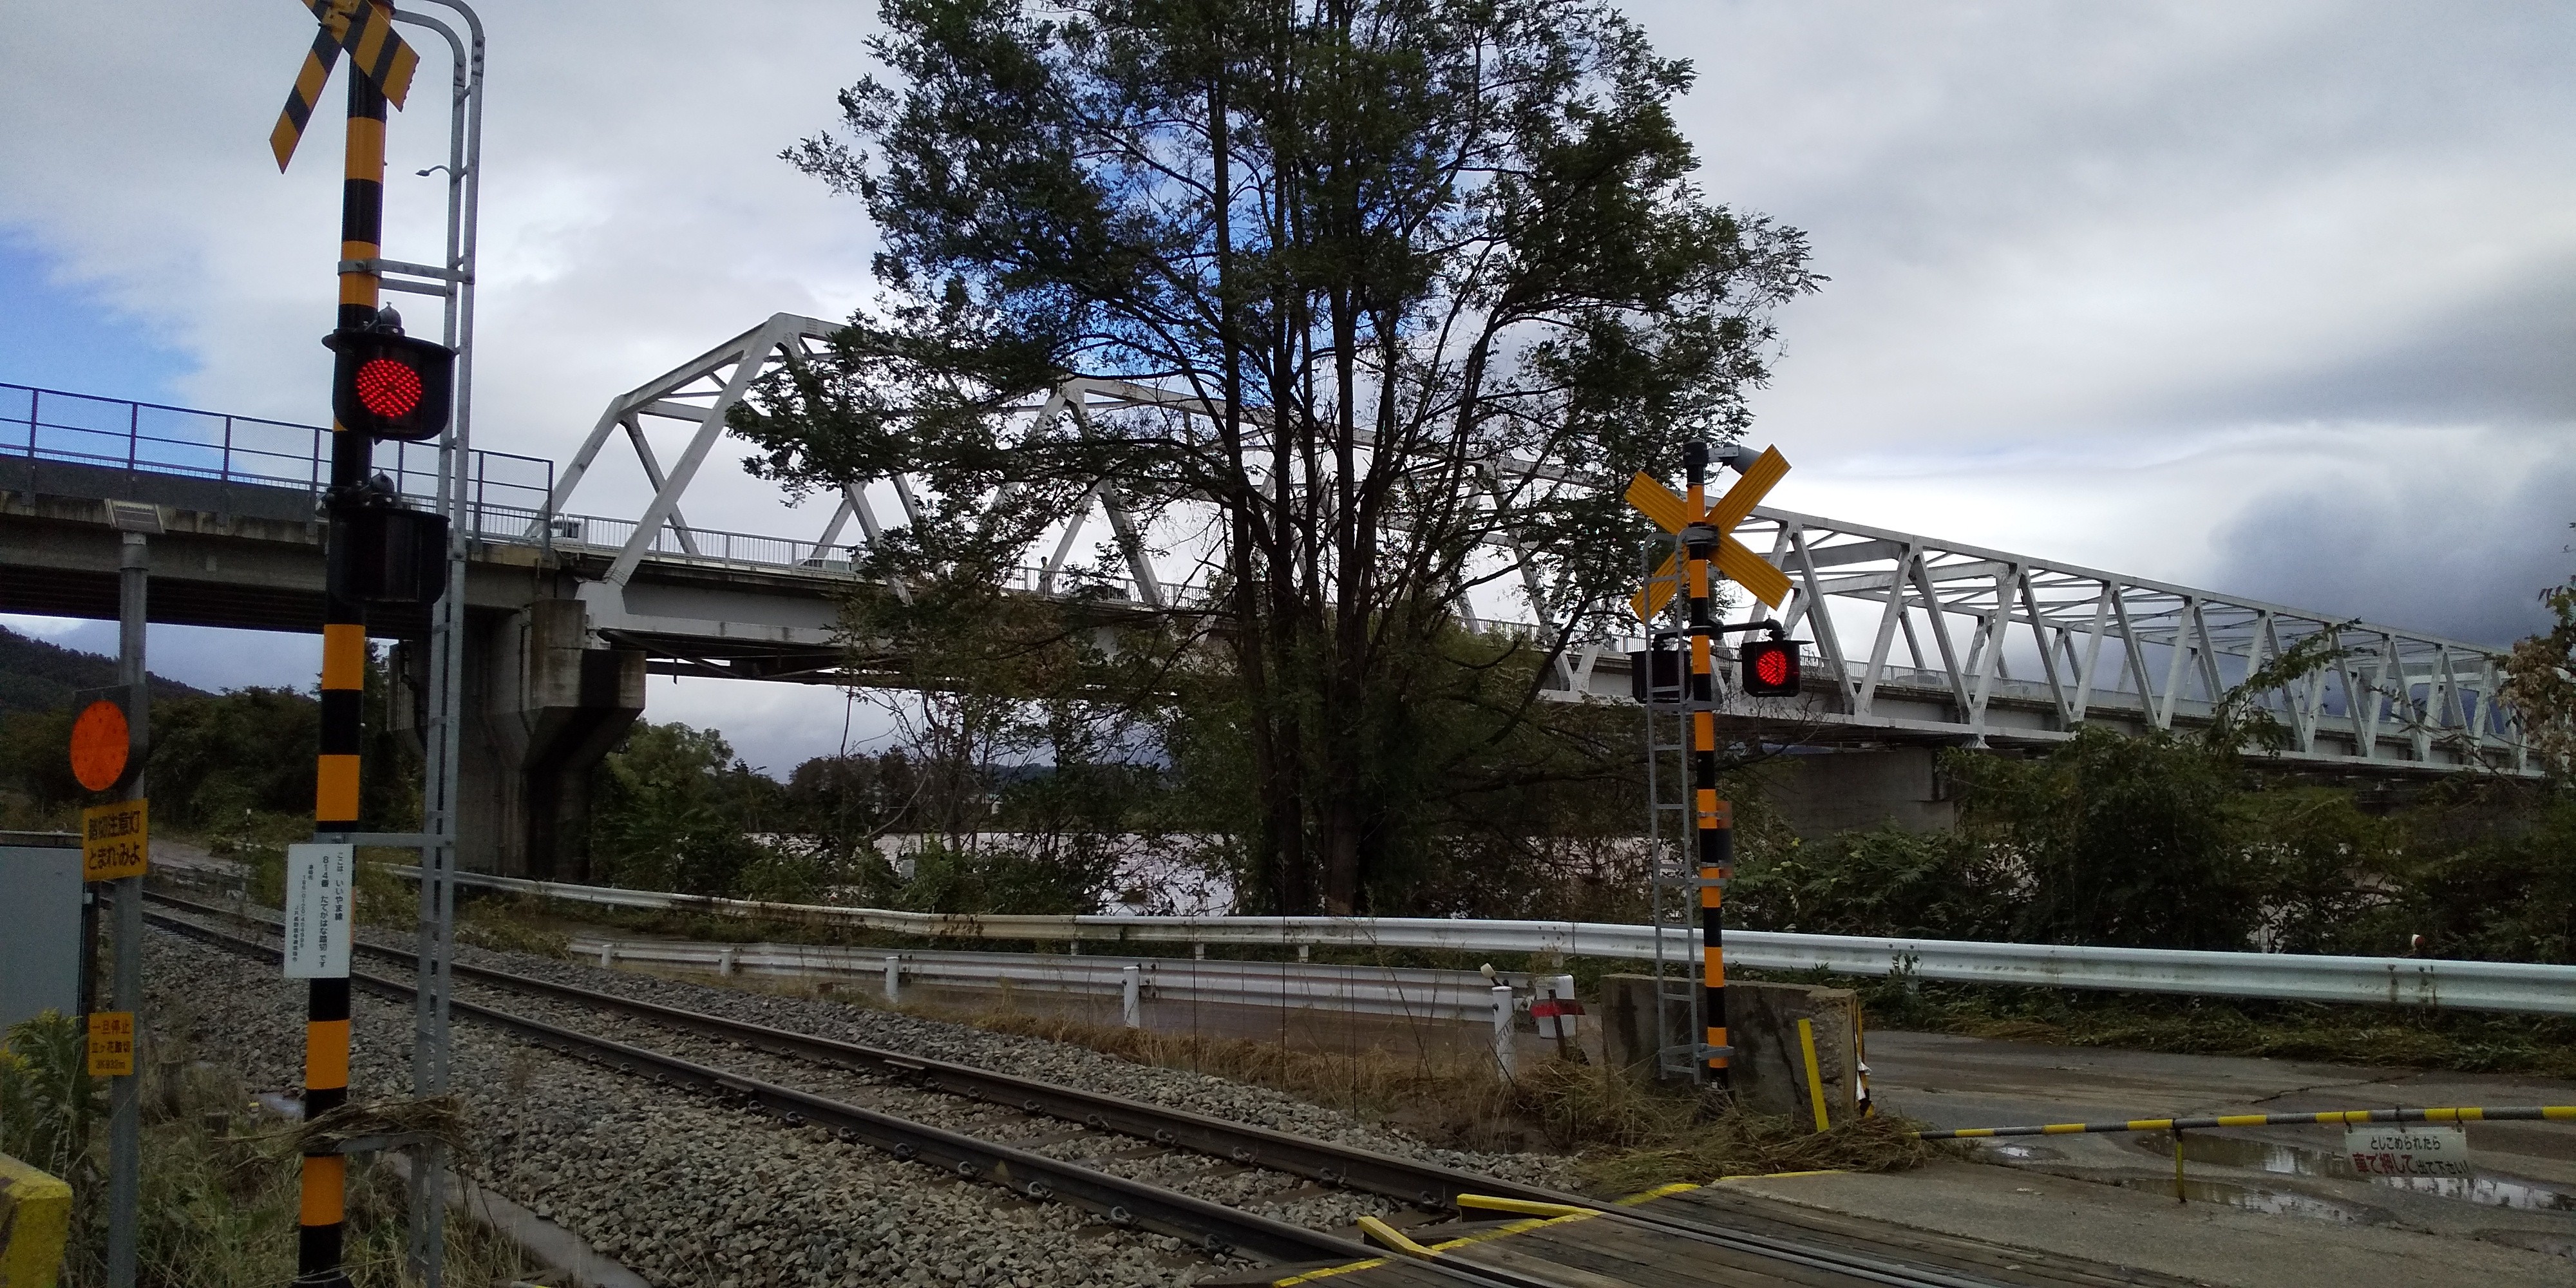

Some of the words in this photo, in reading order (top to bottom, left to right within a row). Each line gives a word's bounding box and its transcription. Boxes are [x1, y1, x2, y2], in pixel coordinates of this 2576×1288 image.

[91, 1019, 131, 1036] 一旦停止
[2370, 1135, 2441, 1151] とじこめられたら
